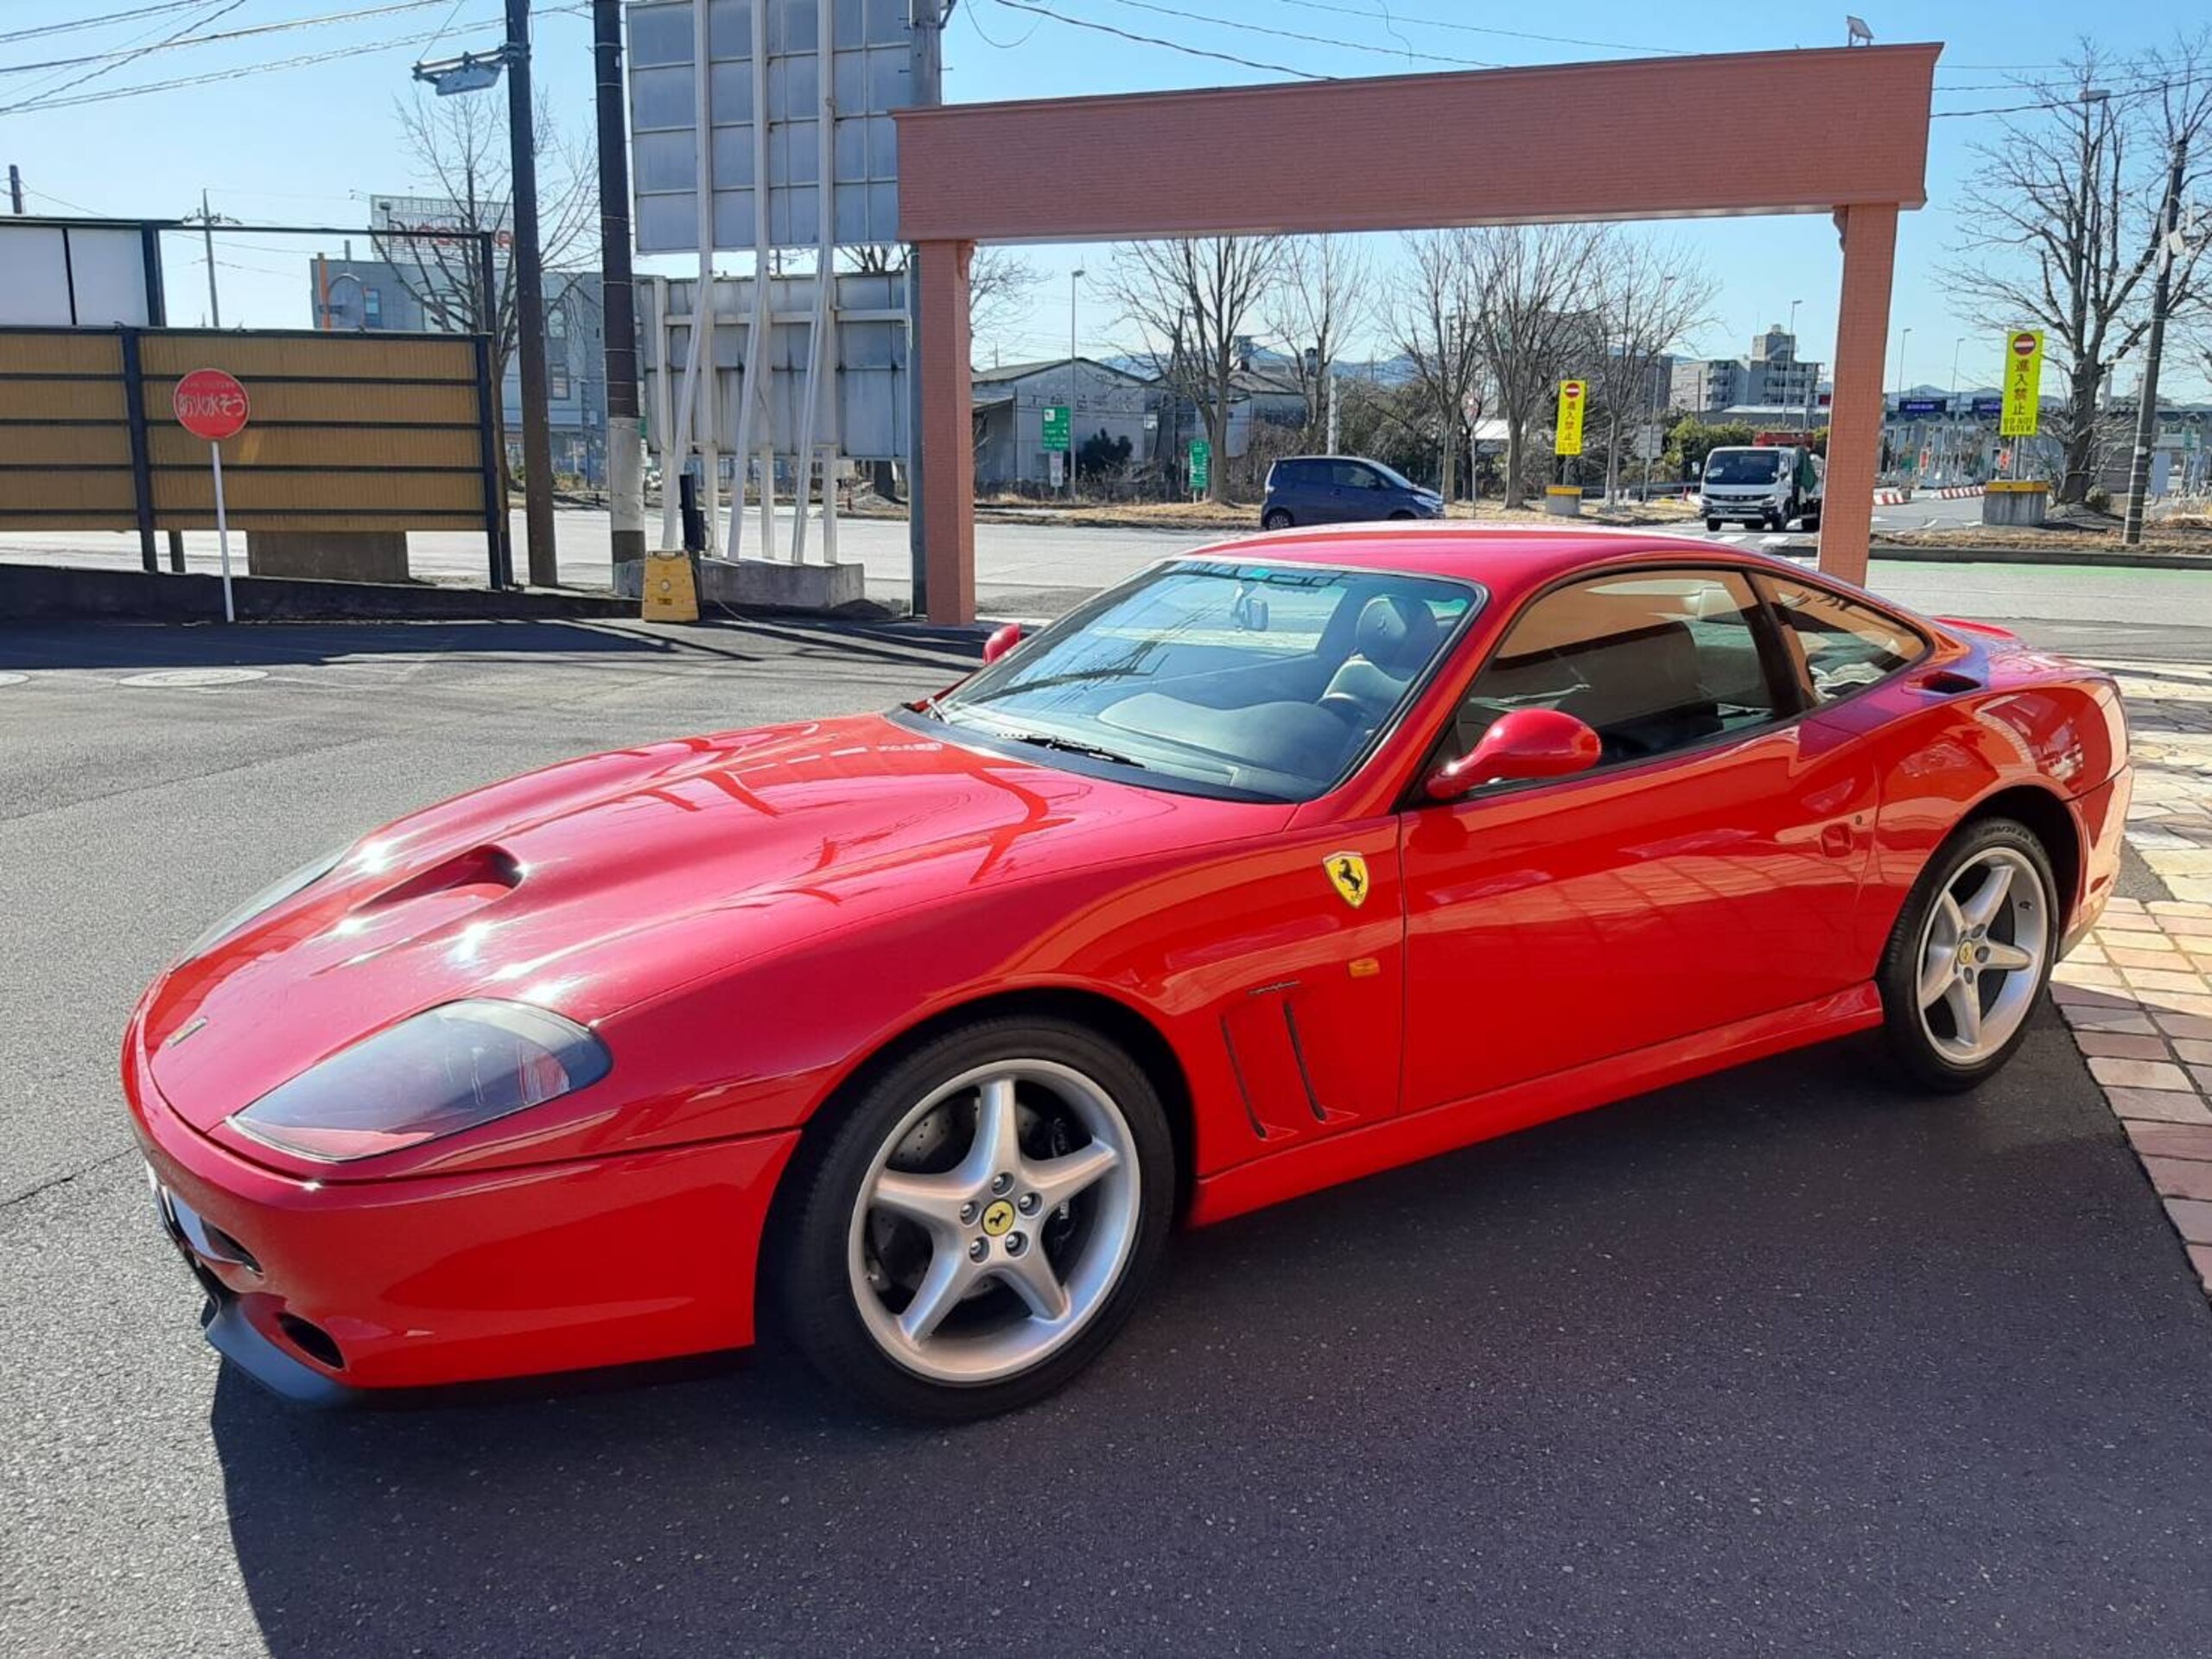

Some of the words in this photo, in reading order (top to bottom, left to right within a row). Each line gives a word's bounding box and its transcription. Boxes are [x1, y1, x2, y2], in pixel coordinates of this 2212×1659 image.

[178, 393, 245, 417] 防火水そう
[2012, 359, 2031, 416] 進入禁止
